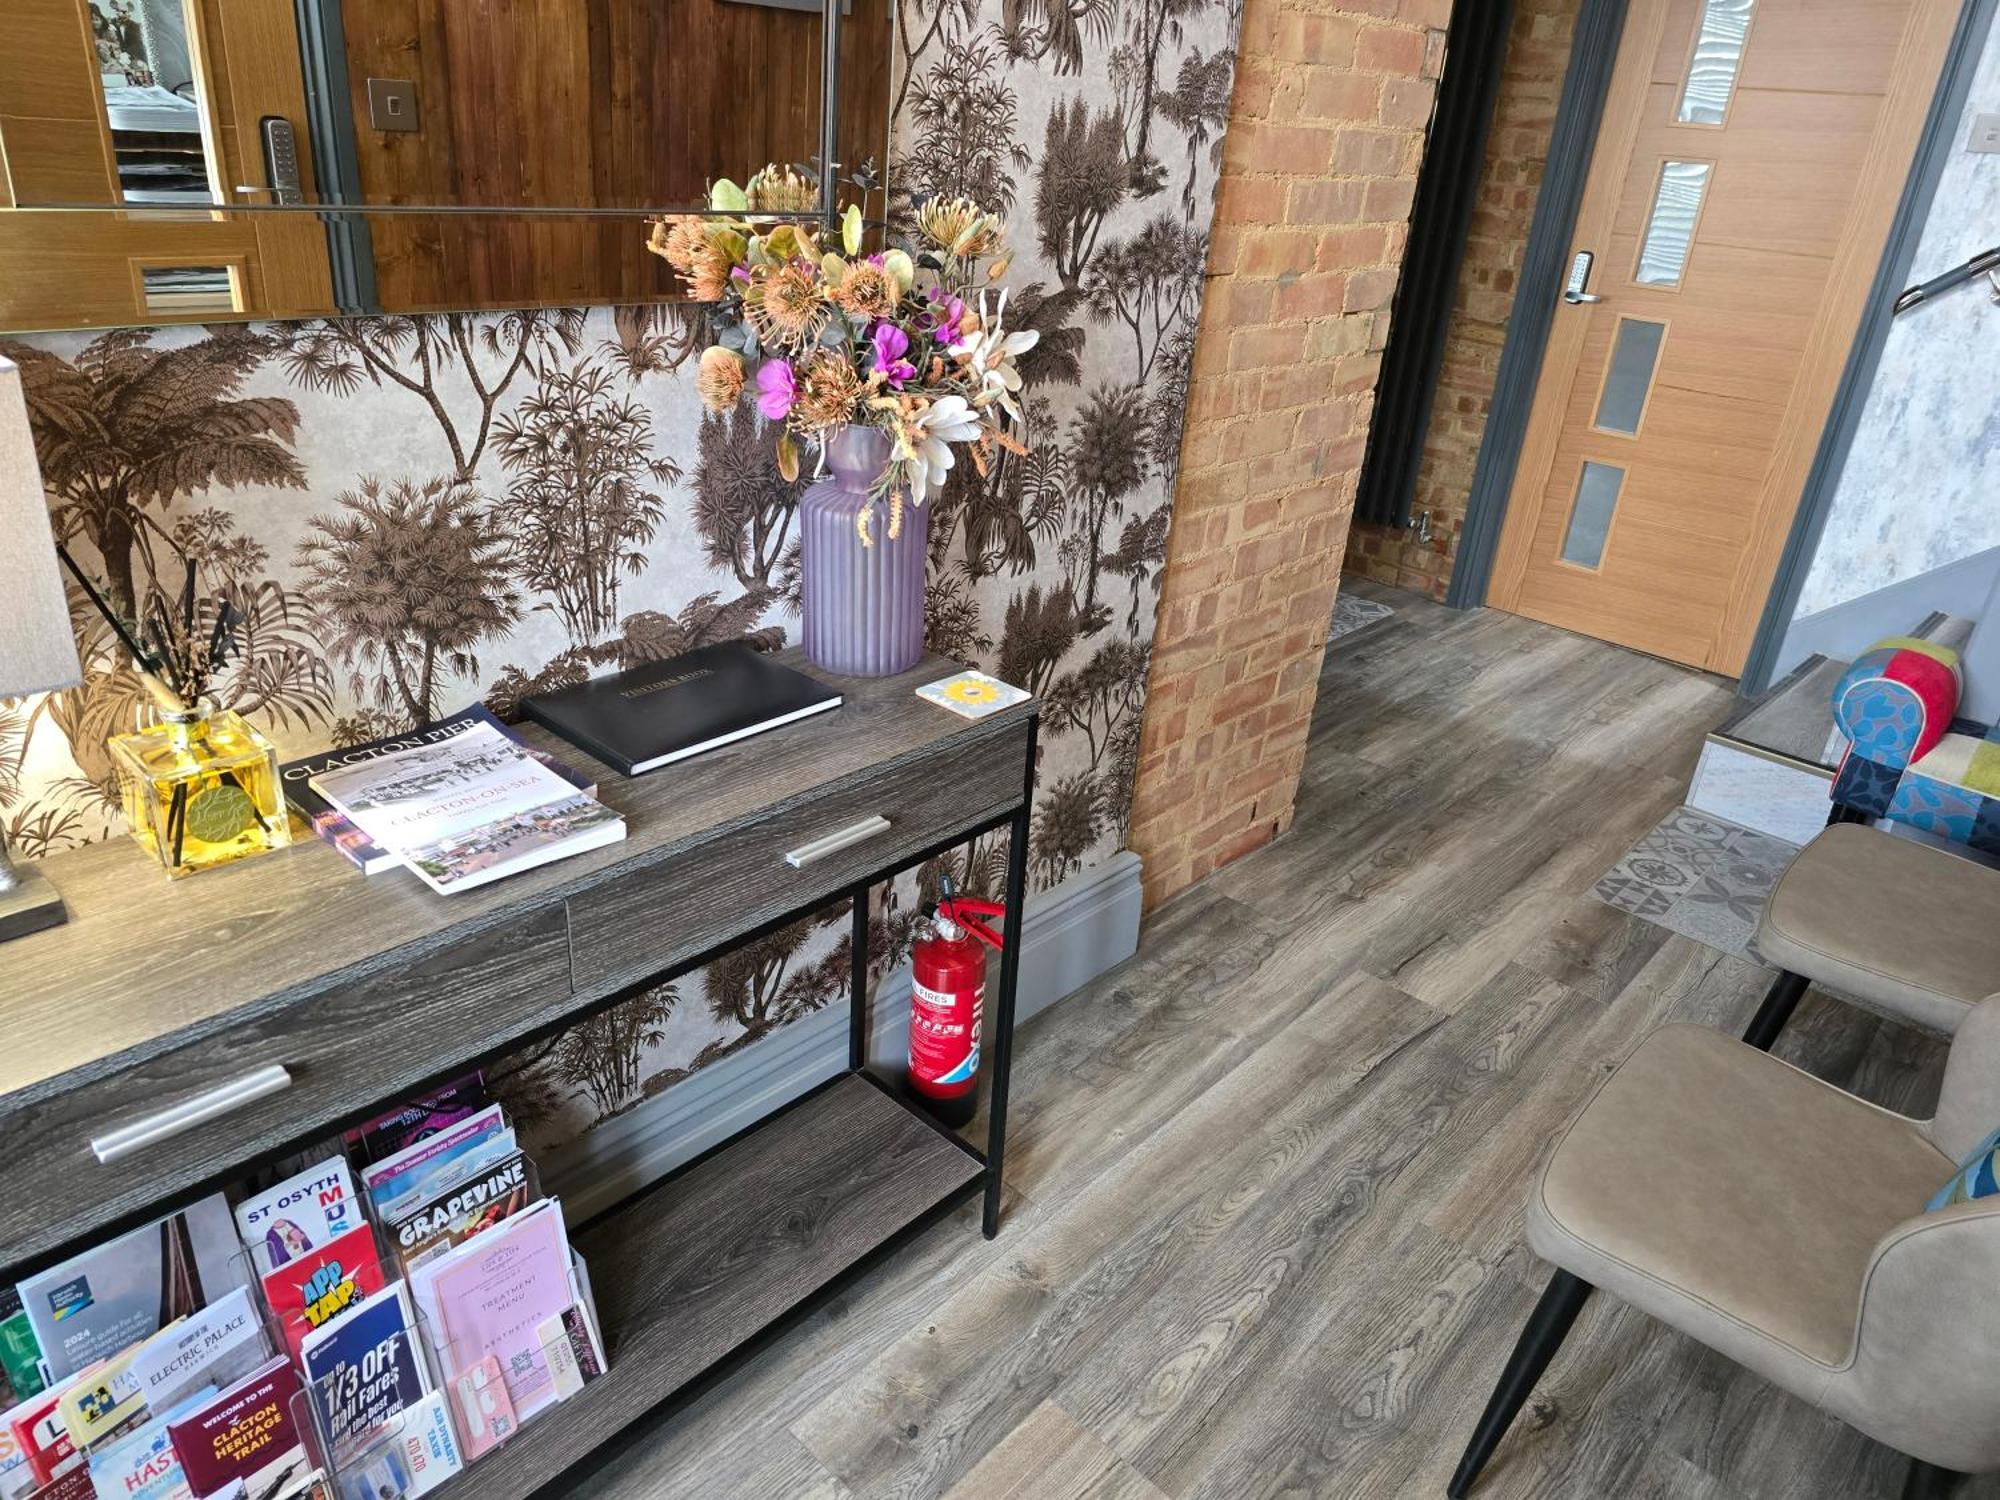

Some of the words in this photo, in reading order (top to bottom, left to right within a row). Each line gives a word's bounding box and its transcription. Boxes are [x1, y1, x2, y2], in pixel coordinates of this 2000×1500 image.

[284, 736, 424, 781] CLACTON
[426, 718, 478, 742] PIER
[919, 990, 948, 1004] FIRES
[248, 1204, 271, 1224] ST
[278, 1173, 340, 1209] OSYTH
[400, 1162, 525, 1247] GRAPEVINE
[303, 1260, 343, 1306] APP
[304, 1279, 356, 1328] TAP
[481, 1274, 537, 1311] TREATMENT
[498, 1293, 525, 1313] MENU
[63, 1327, 91, 1348] 2024
[150, 1344, 201, 1387] ELECTRIC
[204, 1314, 246, 1348] PALACE
[325, 1364, 358, 1418] 1/3
[362, 1331, 400, 1383] OFF
[202, 1401, 245, 1430] WELCOME
[245, 1393, 258, 1406] TO
[257, 1383, 274, 1399] THE
[213, 1402, 278, 1448] CLACTON
[331, 1397, 356, 1438] Rail
[360, 1366, 399, 1410] Fares
[215, 1412, 282, 1461] HERITAGE
[233, 1435, 272, 1462] TRAIL
